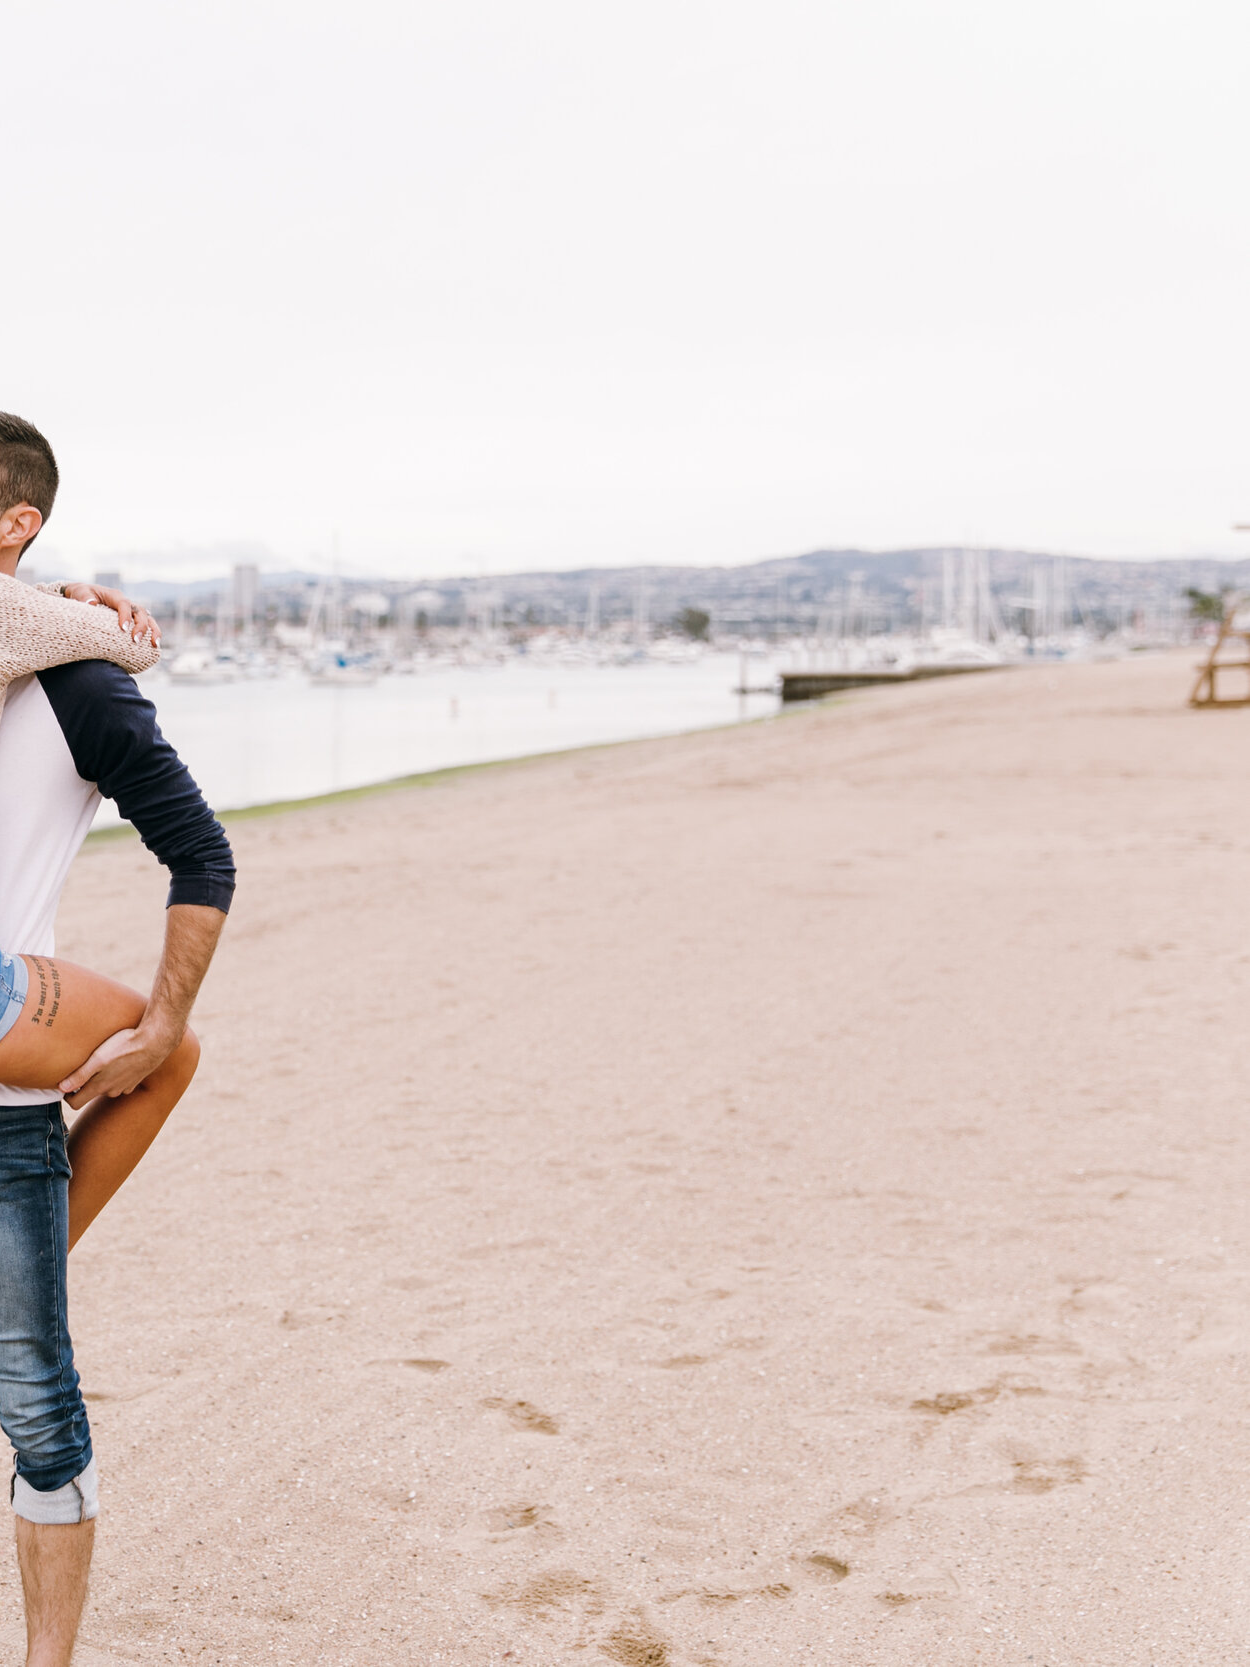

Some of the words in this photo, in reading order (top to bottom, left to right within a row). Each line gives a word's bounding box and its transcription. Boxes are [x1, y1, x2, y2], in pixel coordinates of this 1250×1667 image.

[37, 971, 45, 980] of
[53, 981, 61, 999] with
[49, 1001, 59, 1017] love
